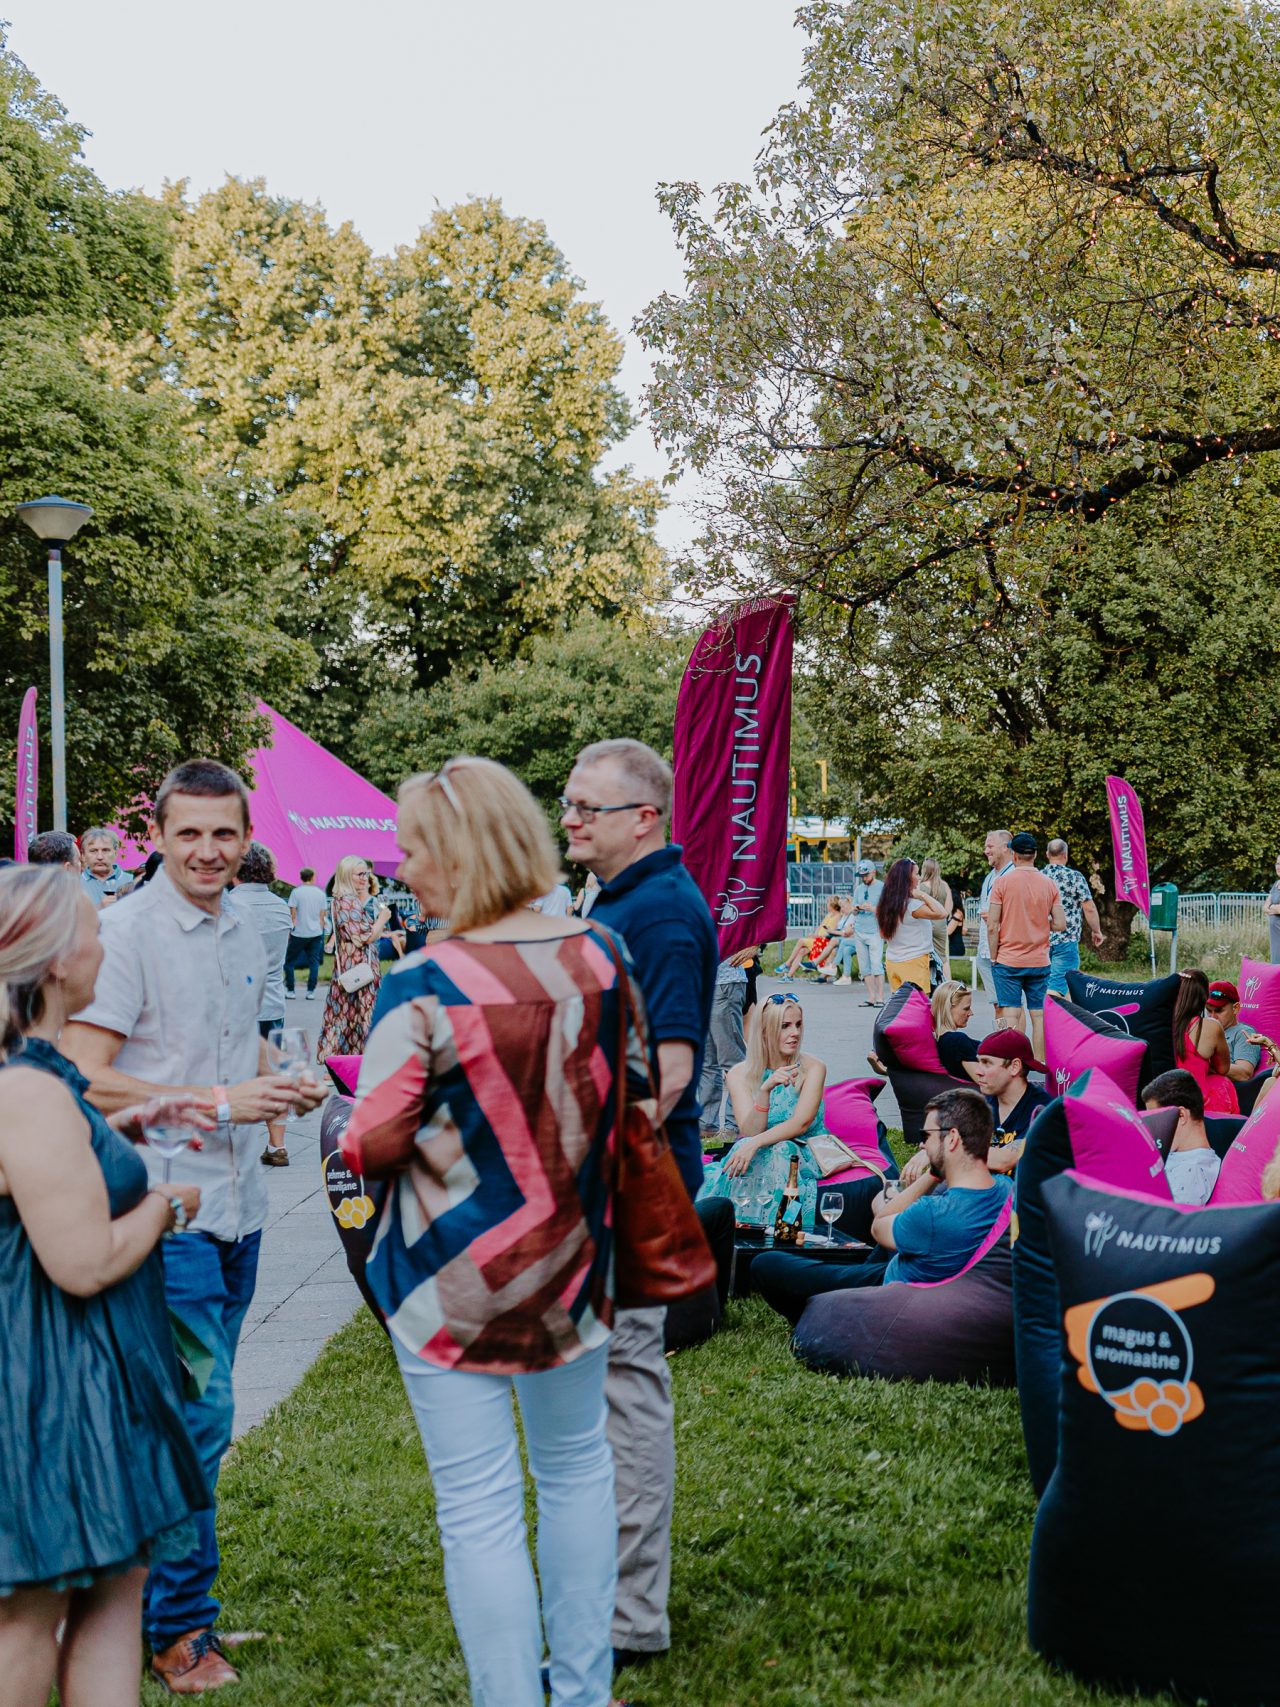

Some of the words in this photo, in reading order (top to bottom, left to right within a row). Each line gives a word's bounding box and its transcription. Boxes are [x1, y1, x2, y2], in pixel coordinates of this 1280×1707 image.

[731, 653, 762, 861] NAUTIMUS
[25, 726, 35, 844] AUTIMUS
[308, 815, 398, 832] NAUTIMUS
[1117, 794, 1134, 872] NAUTIMUS
[1099, 987, 1144, 996] NAUTIMUS
[345, 1169, 353, 1179] &
[1116, 1230, 1222, 1255] NAUTIMUS
[1102, 1324, 1156, 1349] magus
[1157, 1331, 1172, 1349] &
[1094, 1344, 1181, 1371] aromaatne
